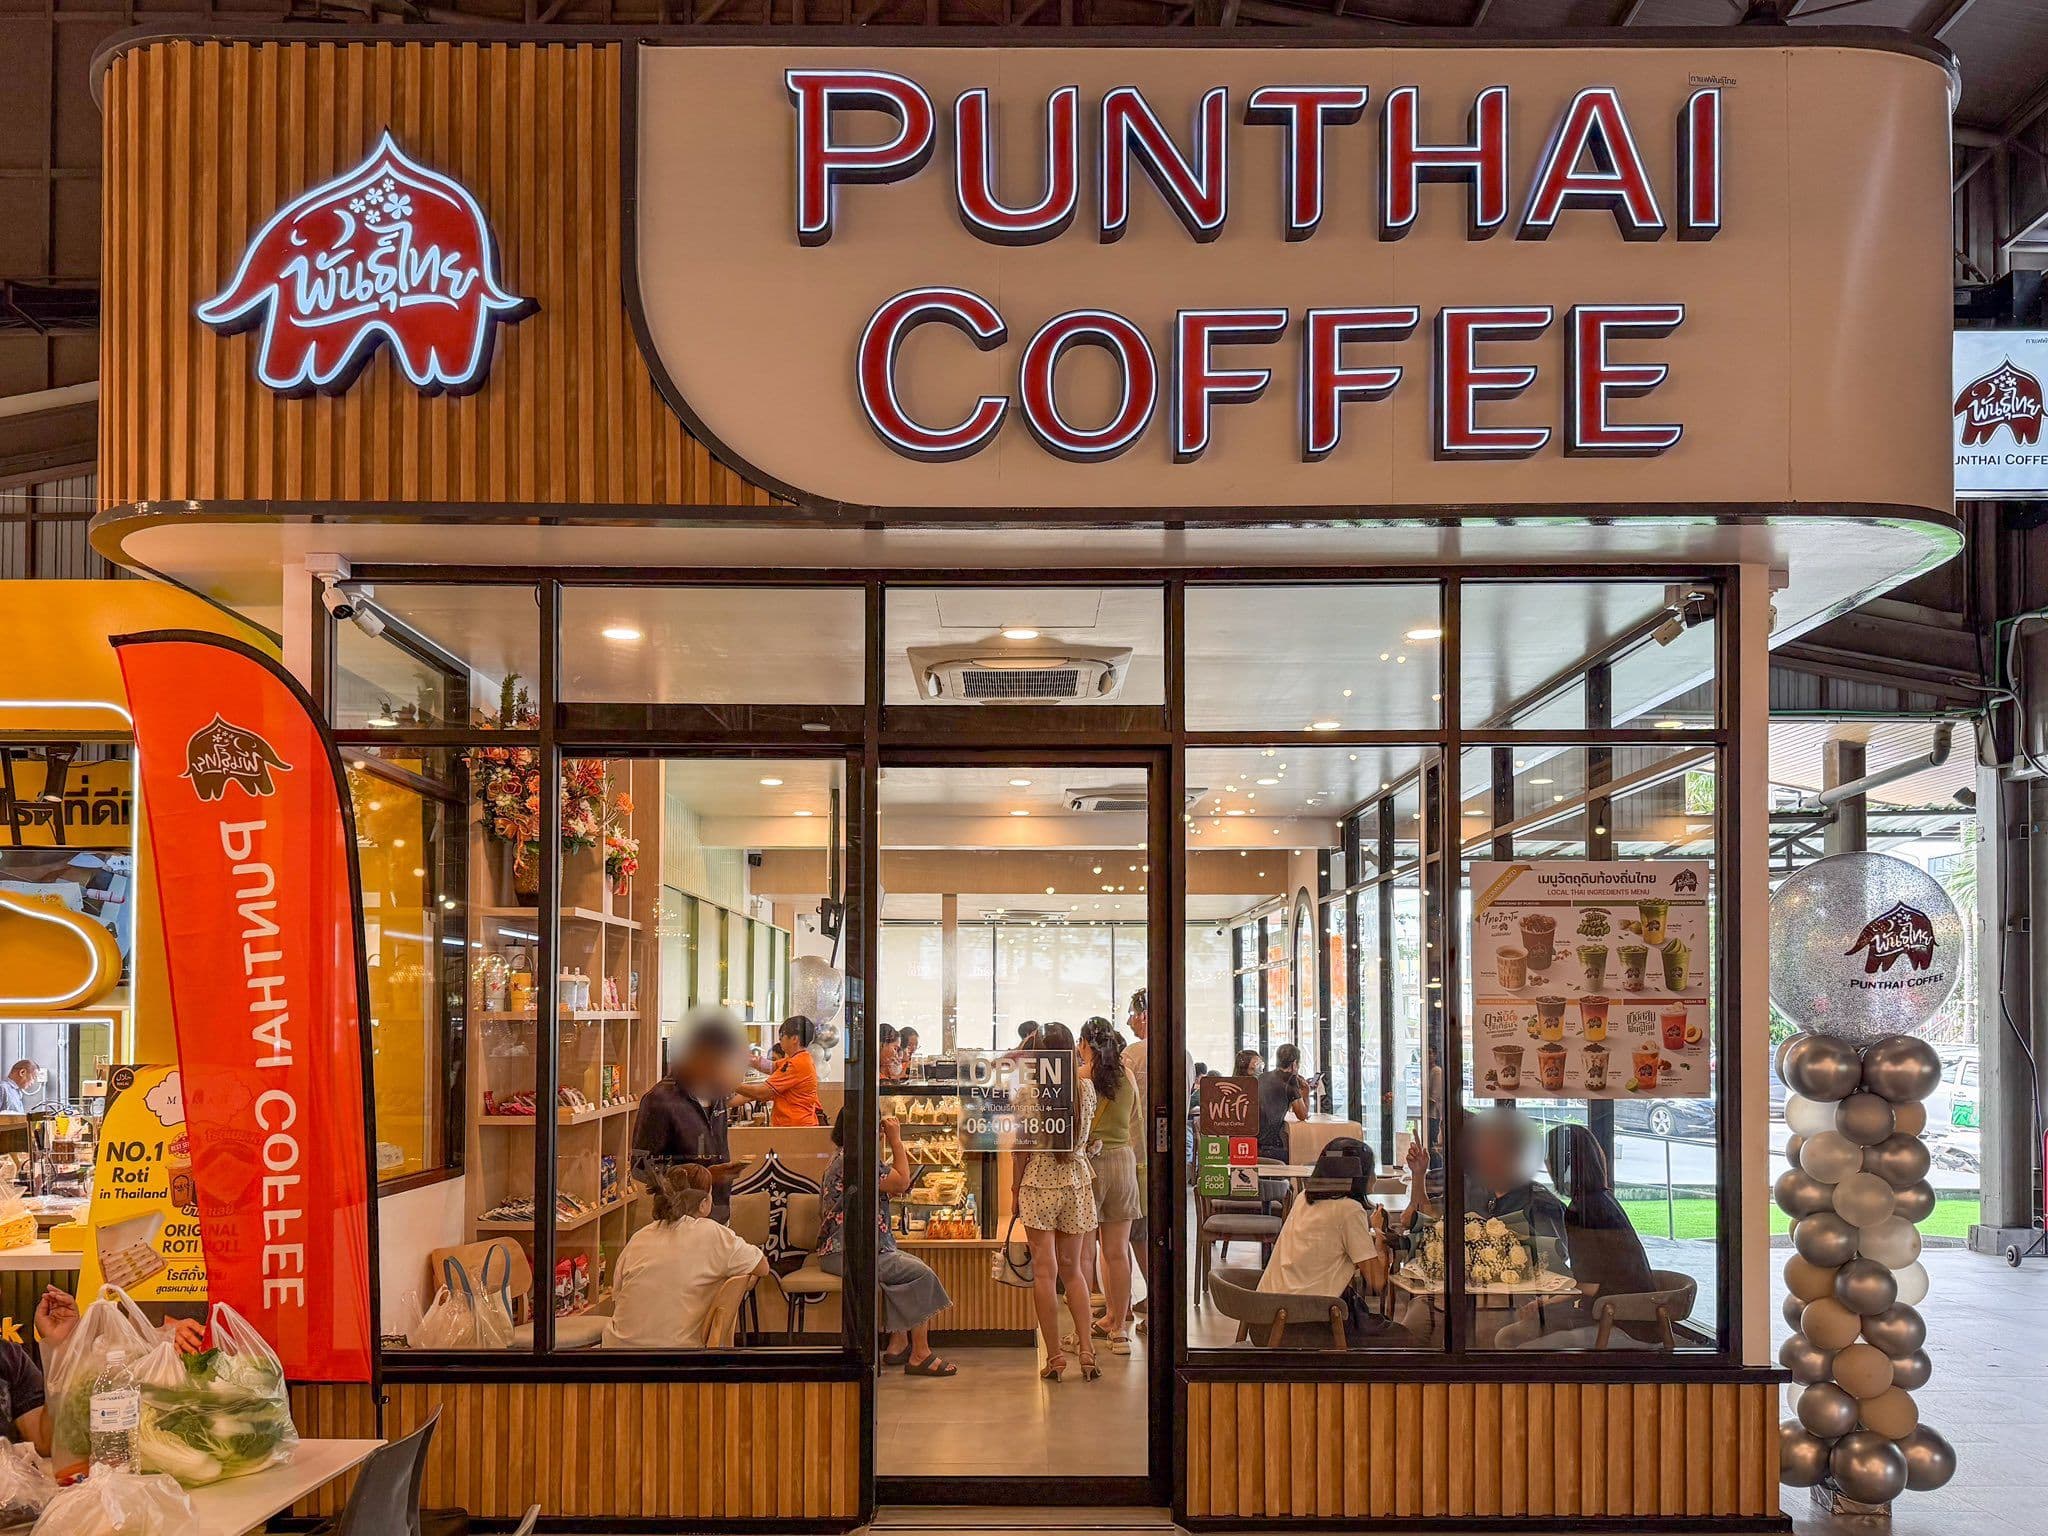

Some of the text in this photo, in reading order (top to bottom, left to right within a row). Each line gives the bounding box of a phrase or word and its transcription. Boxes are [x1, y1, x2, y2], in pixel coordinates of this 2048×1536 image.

[783, 66, 1724, 241] PUNTHAI
[279, 221, 479, 315] พันธุ์ไทย
[855, 285, 1687, 459] COFFEE
[2005, 453, 2048, 465] COFFE
[1538, 869, 1657, 888] เมนูวัตถุดิบท้องถิ่นไทย
[1850, 972, 1945, 990] PUNTHAI COFFEE
[970, 1058, 1061, 1088] OPEN
[1030, 1087, 1062, 1099] DAY
[106, 1141, 164, 1162] NO.1
[112, 1166, 149, 1183] Roti
[1205, 1174, 1225, 1183] Grab
[100, 1188, 111, 1199] in
[115, 1187, 168, 1199] Thailand
[1205, 1181, 1225, 1190] Food
[164, 1224, 239, 1238] ORIGNAL
[162, 1240, 198, 1253] ROTI
